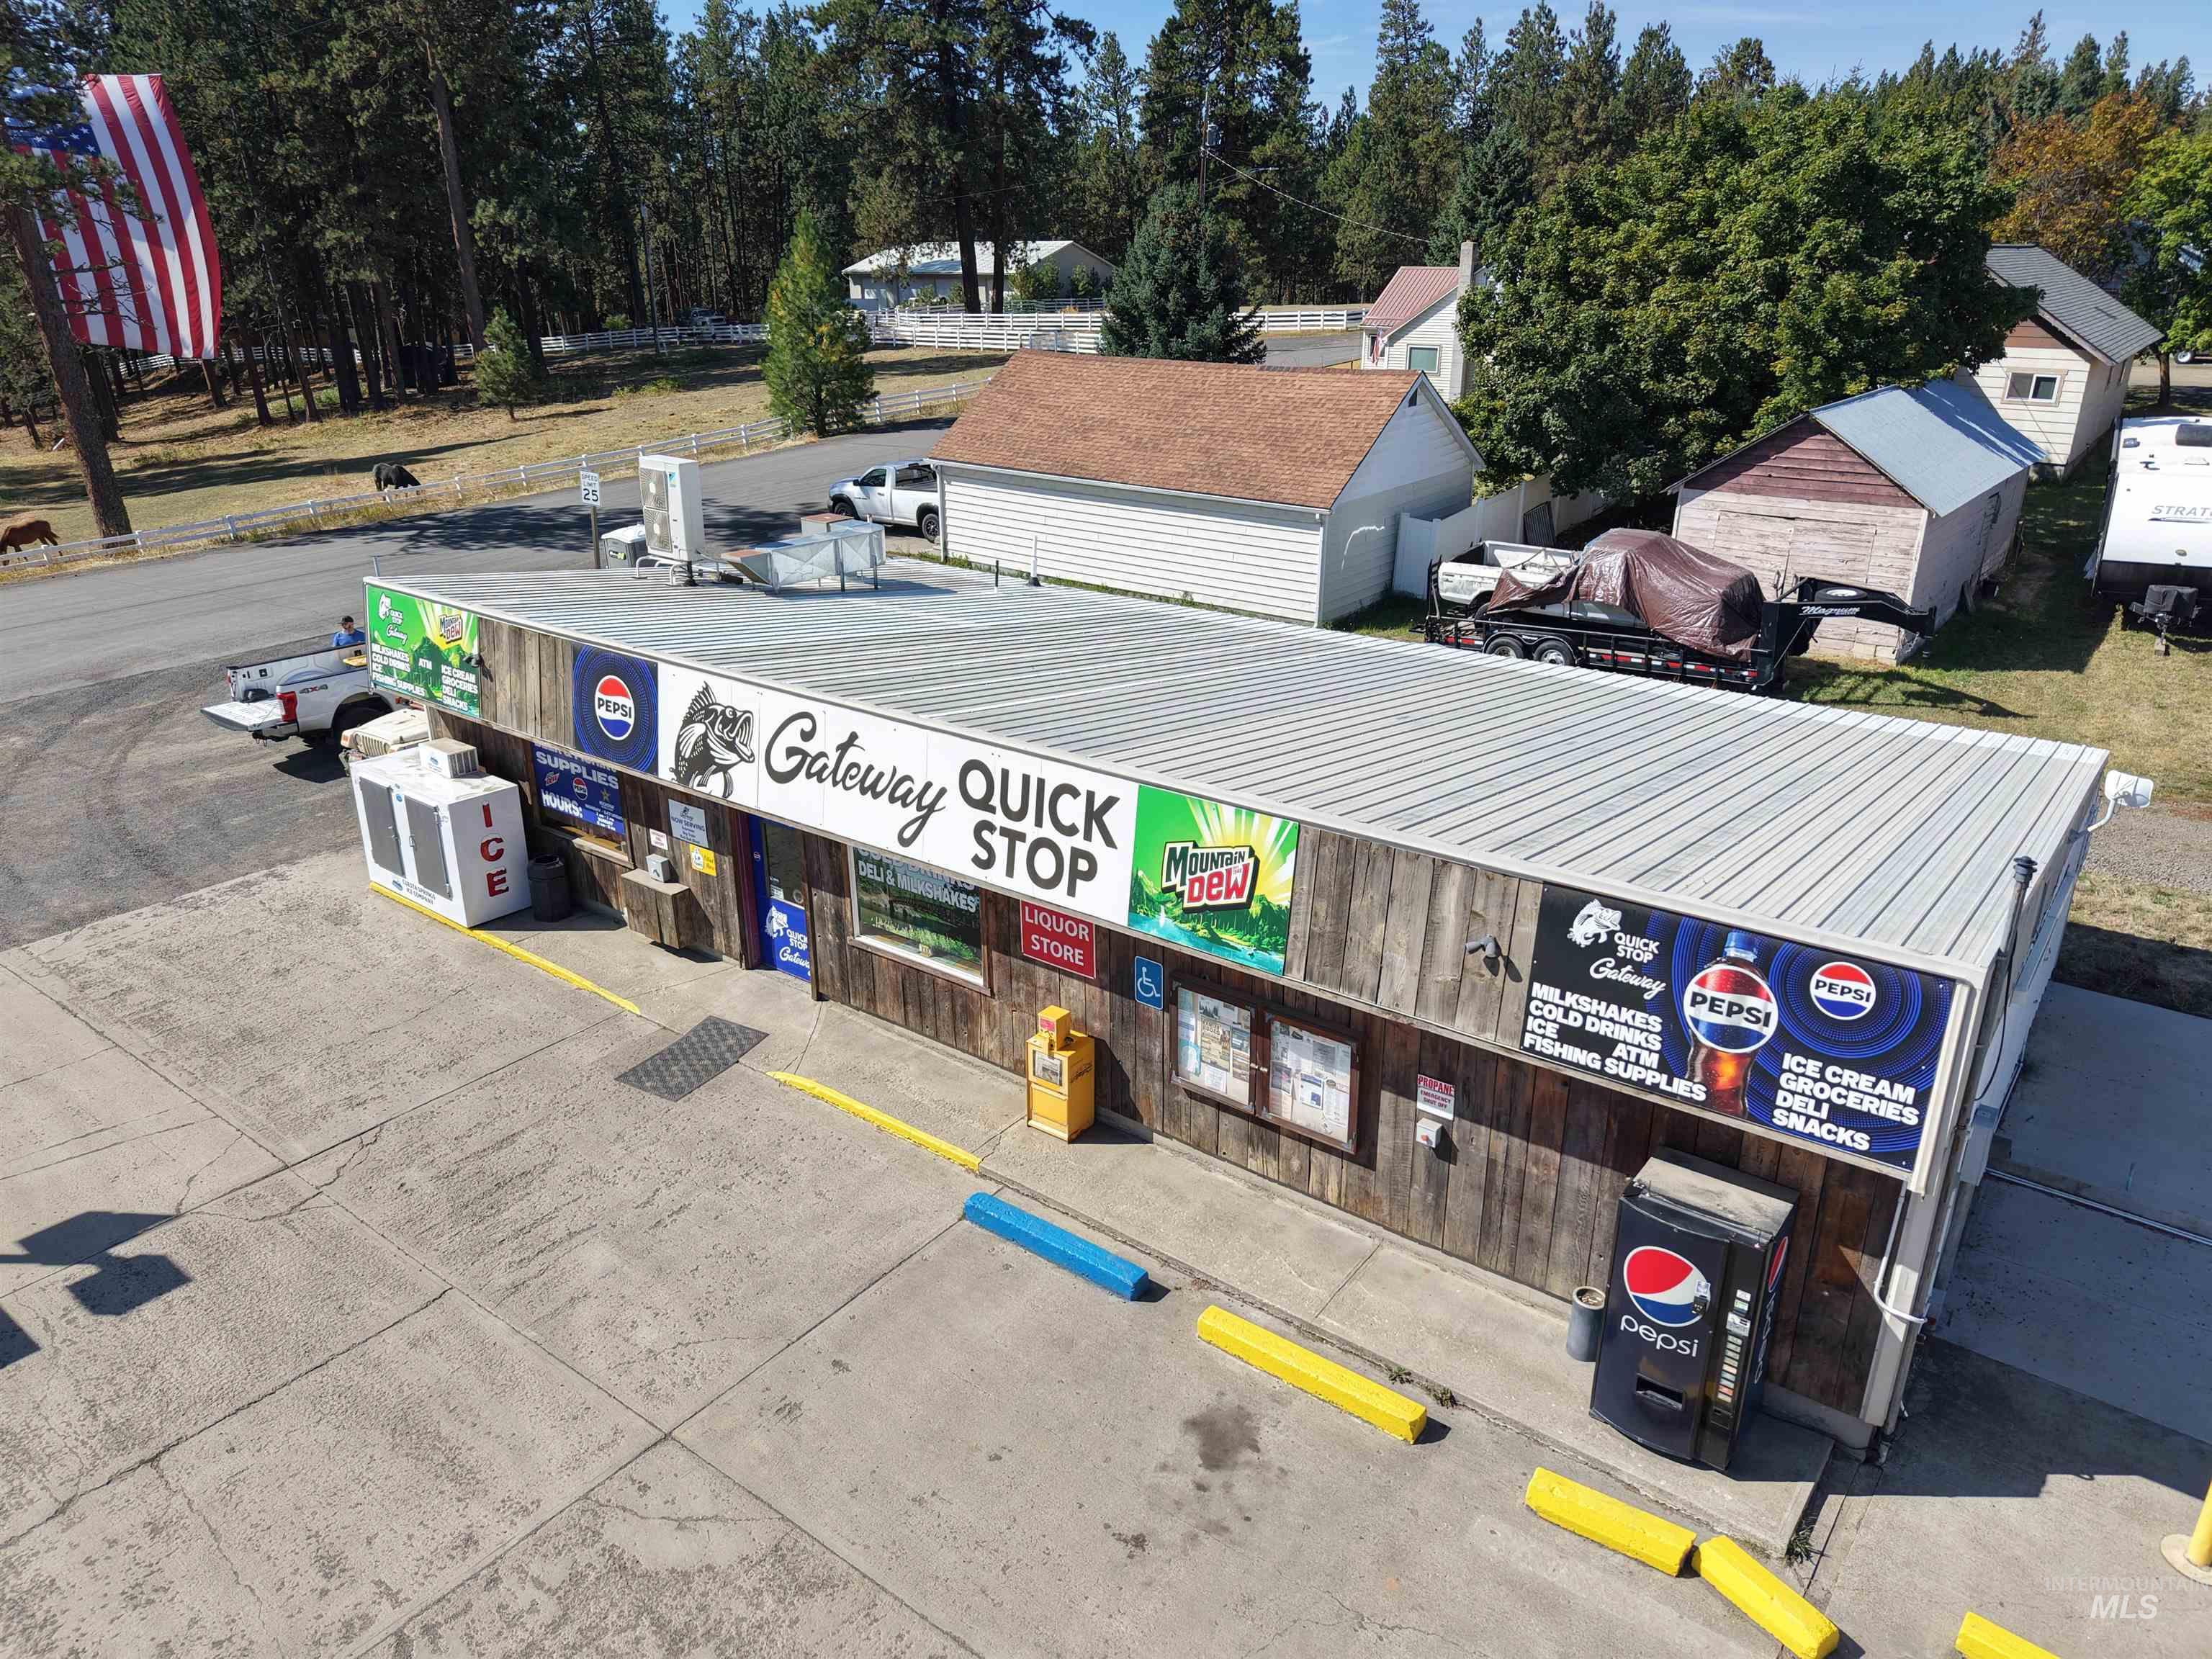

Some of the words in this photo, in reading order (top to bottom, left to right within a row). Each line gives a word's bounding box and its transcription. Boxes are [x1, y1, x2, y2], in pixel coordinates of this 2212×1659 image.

[583, 488, 599, 502] 25
[1799, 606, 1861, 616] Magnum
[372, 643, 410, 662] MILKSHAKES
[372, 651, 390, 665] COLD
[389, 656, 410, 673] DRINKS
[418, 658, 432, 670] ATM
[372, 662, 382, 673] ICE
[441, 665, 452, 676] ICE
[452, 667, 476, 683] CREAM
[372, 673, 397, 685] FISHING
[397, 678, 426, 696] SUPPLIES
[441, 675, 478, 694] GROCERIES
[442, 685, 457, 697] DELI
[442, 696, 469, 711] SNACKS
[597, 696, 632, 719] PEPSI
[535, 750, 619, 790] SUPPLIES
[765, 711, 948, 848] Gateway
[958, 759, 1120, 850] QUICK
[541, 789, 583, 819] HOURS:
[671, 815, 683, 824] NOW
[683, 820, 706, 832] SERVING
[480, 800, 510, 897] ICE
[971, 819, 1098, 898] STOP
[858, 860, 885, 883] DELI
[886, 869, 896, 887] &
[896, 873, 976, 914] MILKSHAKES
[1025, 906, 1089, 942] LIQUOR
[789, 938, 808, 951] STOP
[1031, 934, 1084, 966] STORE
[1614, 932, 1660, 954] QUICK
[1617, 945, 1654, 963] STOP
[779, 946, 811, 976] Gatewa
[1589, 958, 1666, 999] Gateway
[1815, 979, 1871, 1003] PEPSI
[1532, 982, 1663, 1033] MILKSHAKES
[1689, 991, 1772, 1028] PEPSI
[1527, 1015, 1560, 1040] ICE
[1529, 999, 1583, 1028] COLD
[1585, 1016, 1663, 1051] DRINKS
[1523, 1032, 1602, 1071] FISHING
[1604, 1057, 1707, 1102] SUPPLIES
[1612, 1043, 1660, 1069] ATM
[1417, 1076, 1454, 1095] PROPANE
[1782, 1053, 1822, 1079] ICE
[1825, 1066, 1916, 1105] CREAM
[1421, 1089, 1450, 1104] EMERGENCY
[1423, 1097, 1437, 1106] SHUT
[1776, 1089, 1830, 1120] DELI
[1779, 1072, 1920, 1125] GROCERIES
[1772, 1108, 1871, 1151] SNACKS
[1619, 1314, 1699, 1358] pepsi
